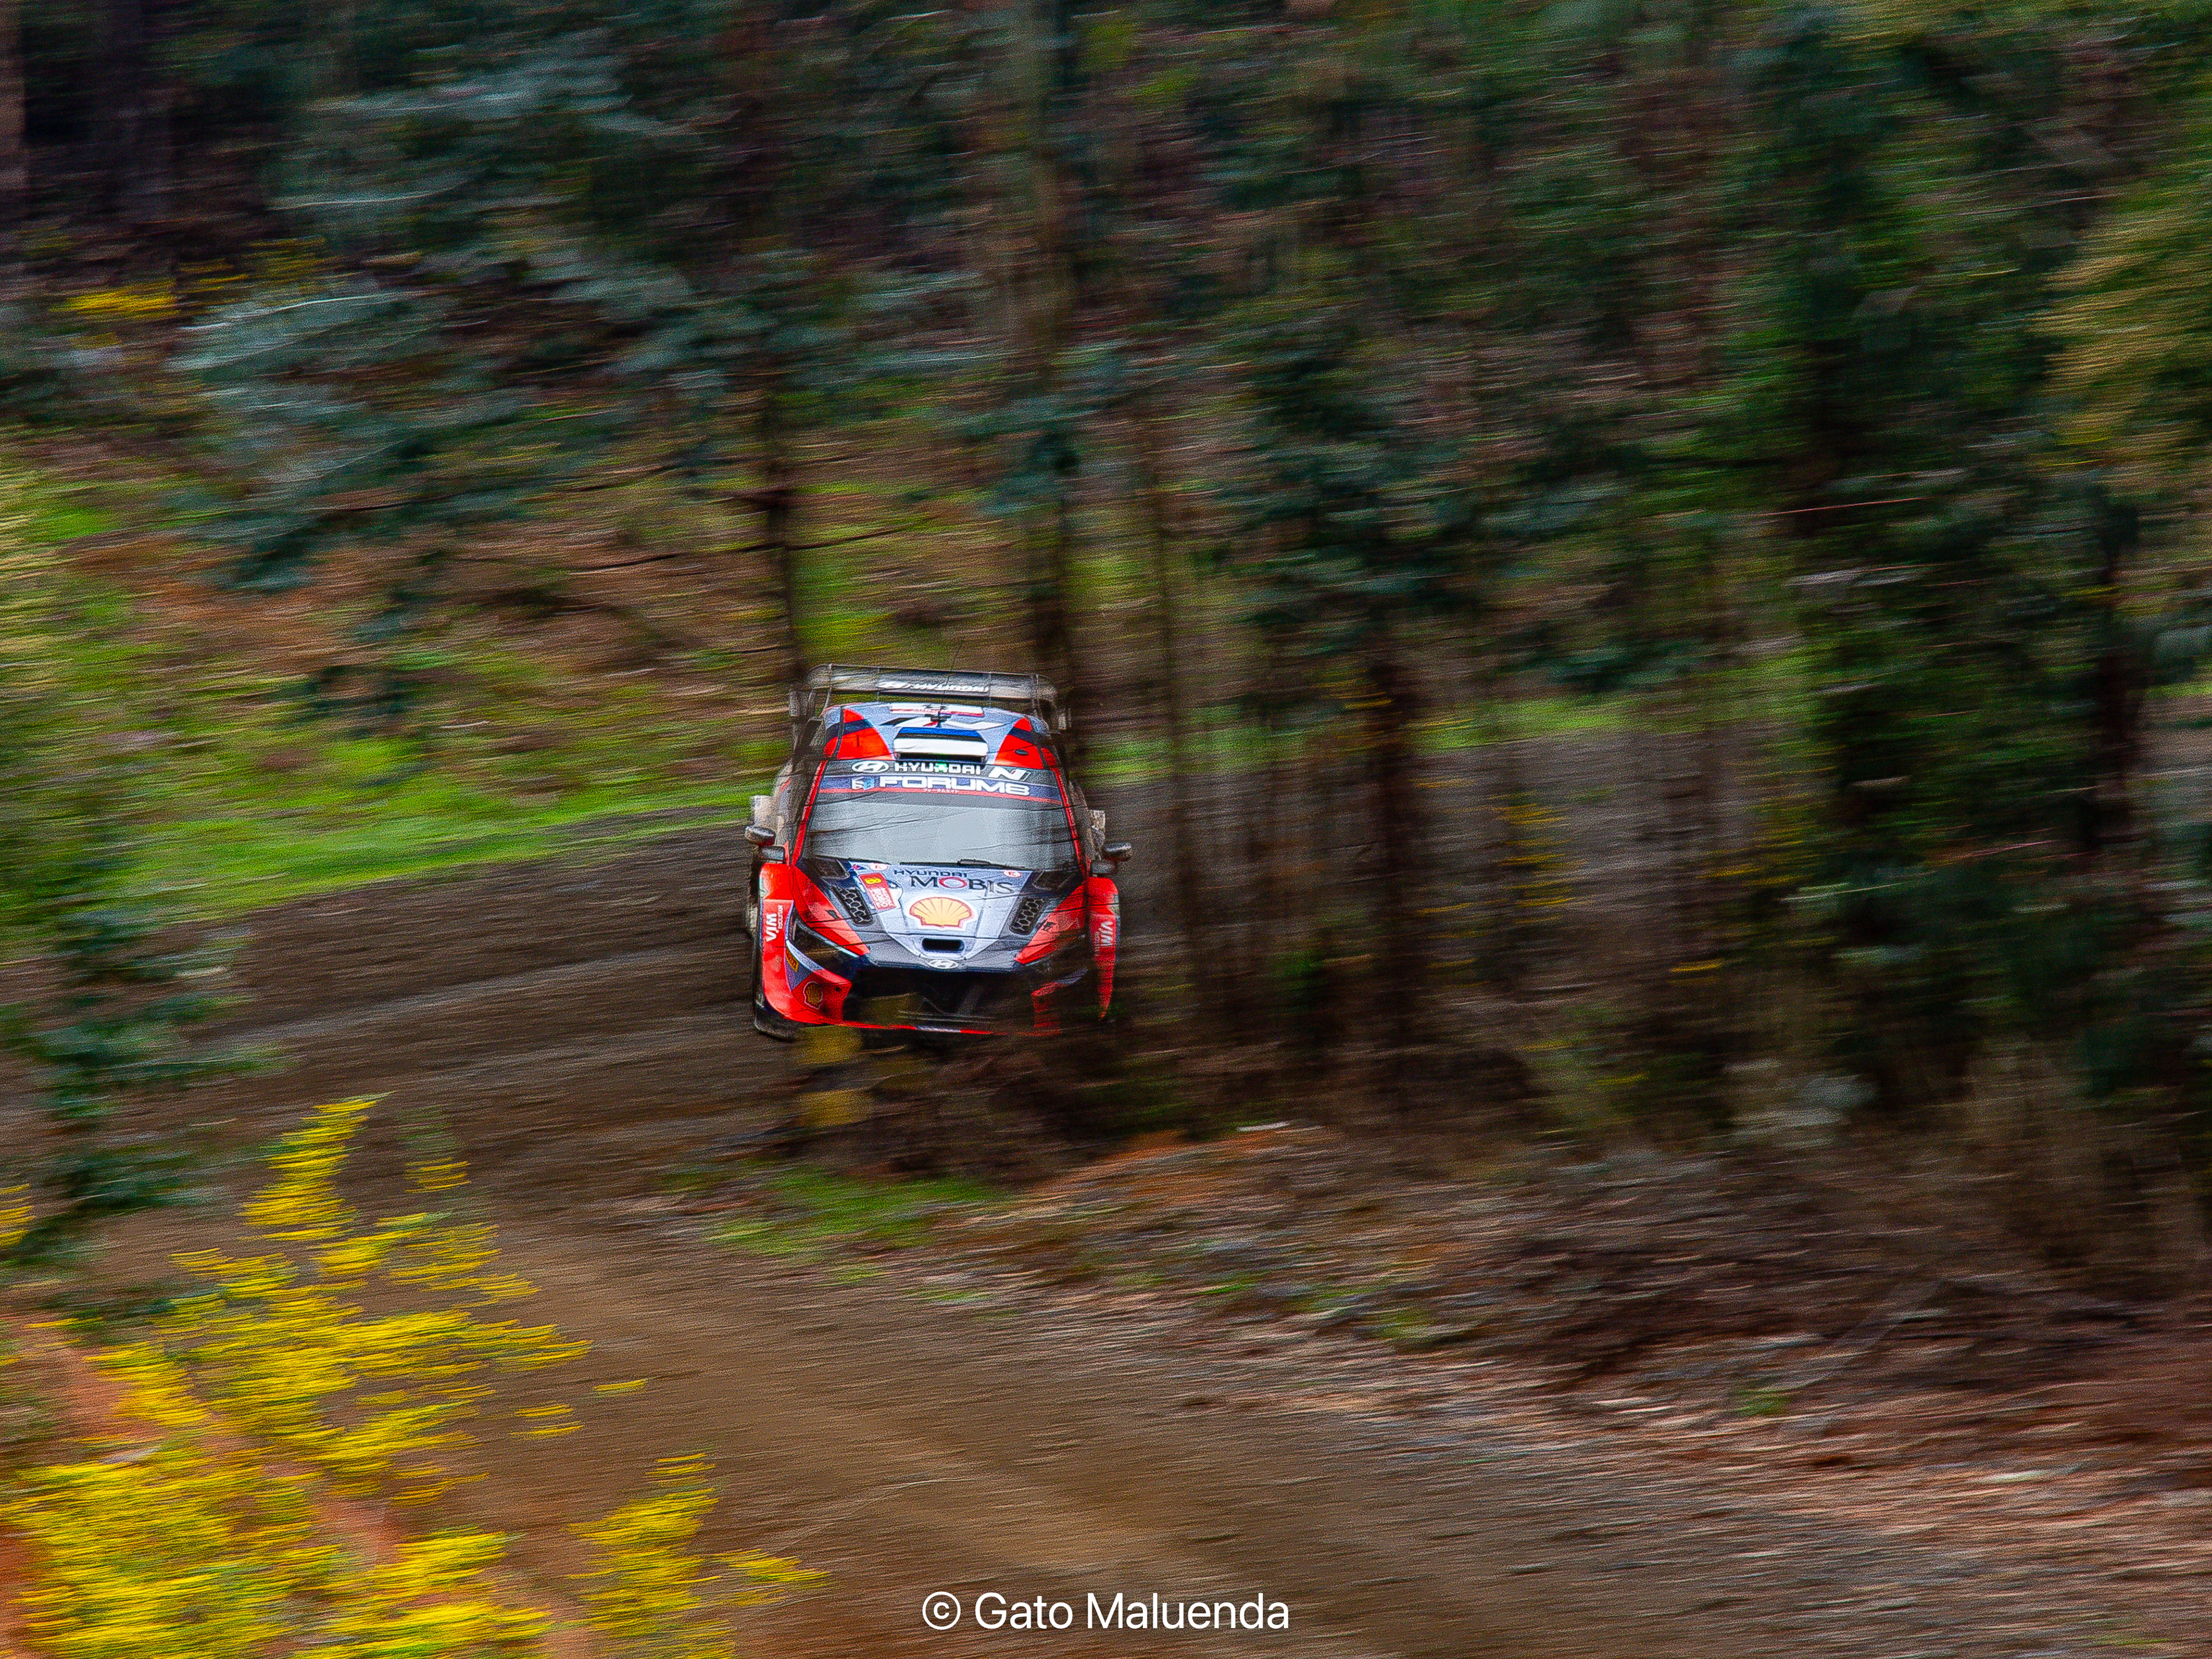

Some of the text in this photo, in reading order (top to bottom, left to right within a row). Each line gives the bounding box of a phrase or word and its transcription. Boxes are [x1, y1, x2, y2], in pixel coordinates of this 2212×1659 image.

[879, 775, 1030, 796] FORUM8
[894, 870, 968, 878] HYUNDAI
[911, 875, 1015, 894] MOBIS
